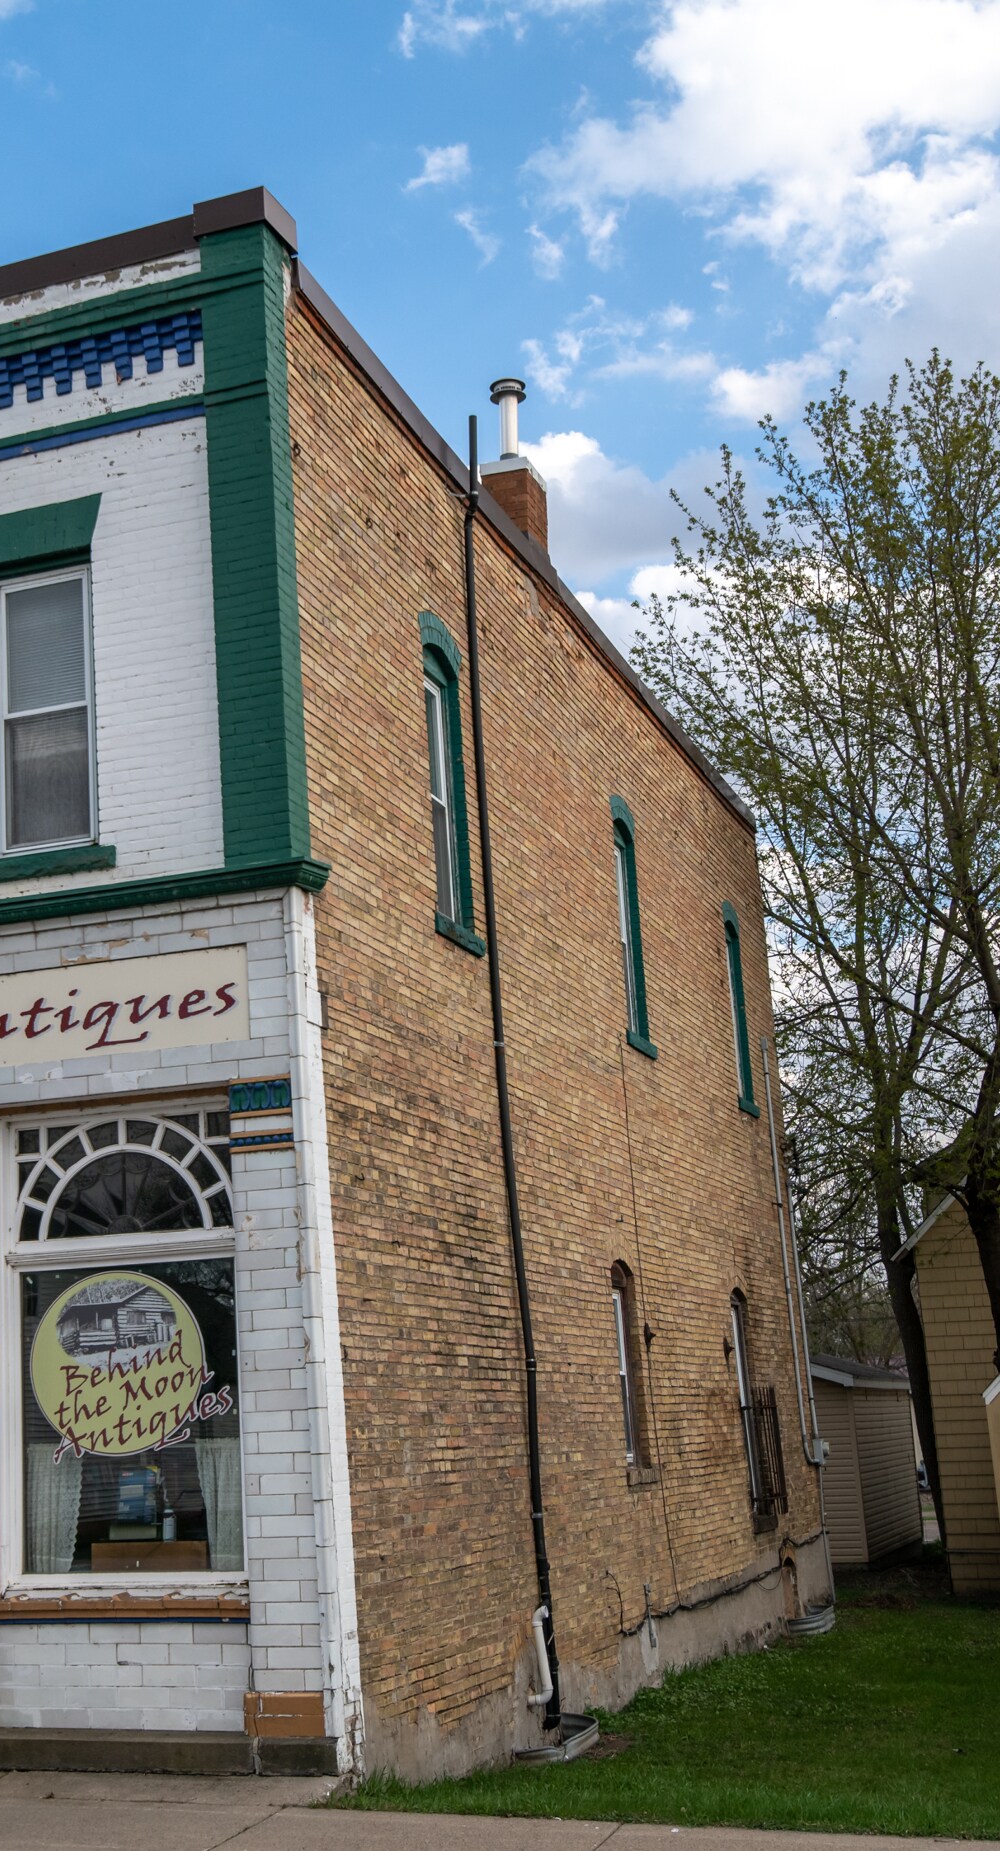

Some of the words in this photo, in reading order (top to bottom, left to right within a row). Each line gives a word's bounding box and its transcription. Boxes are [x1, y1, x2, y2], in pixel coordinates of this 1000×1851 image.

[60, 1329, 191, 1397] Behind
[53, 1386, 234, 1464] Antiques
[54, 1390, 112, 1430] the
[119, 1365, 212, 1410] Moon
